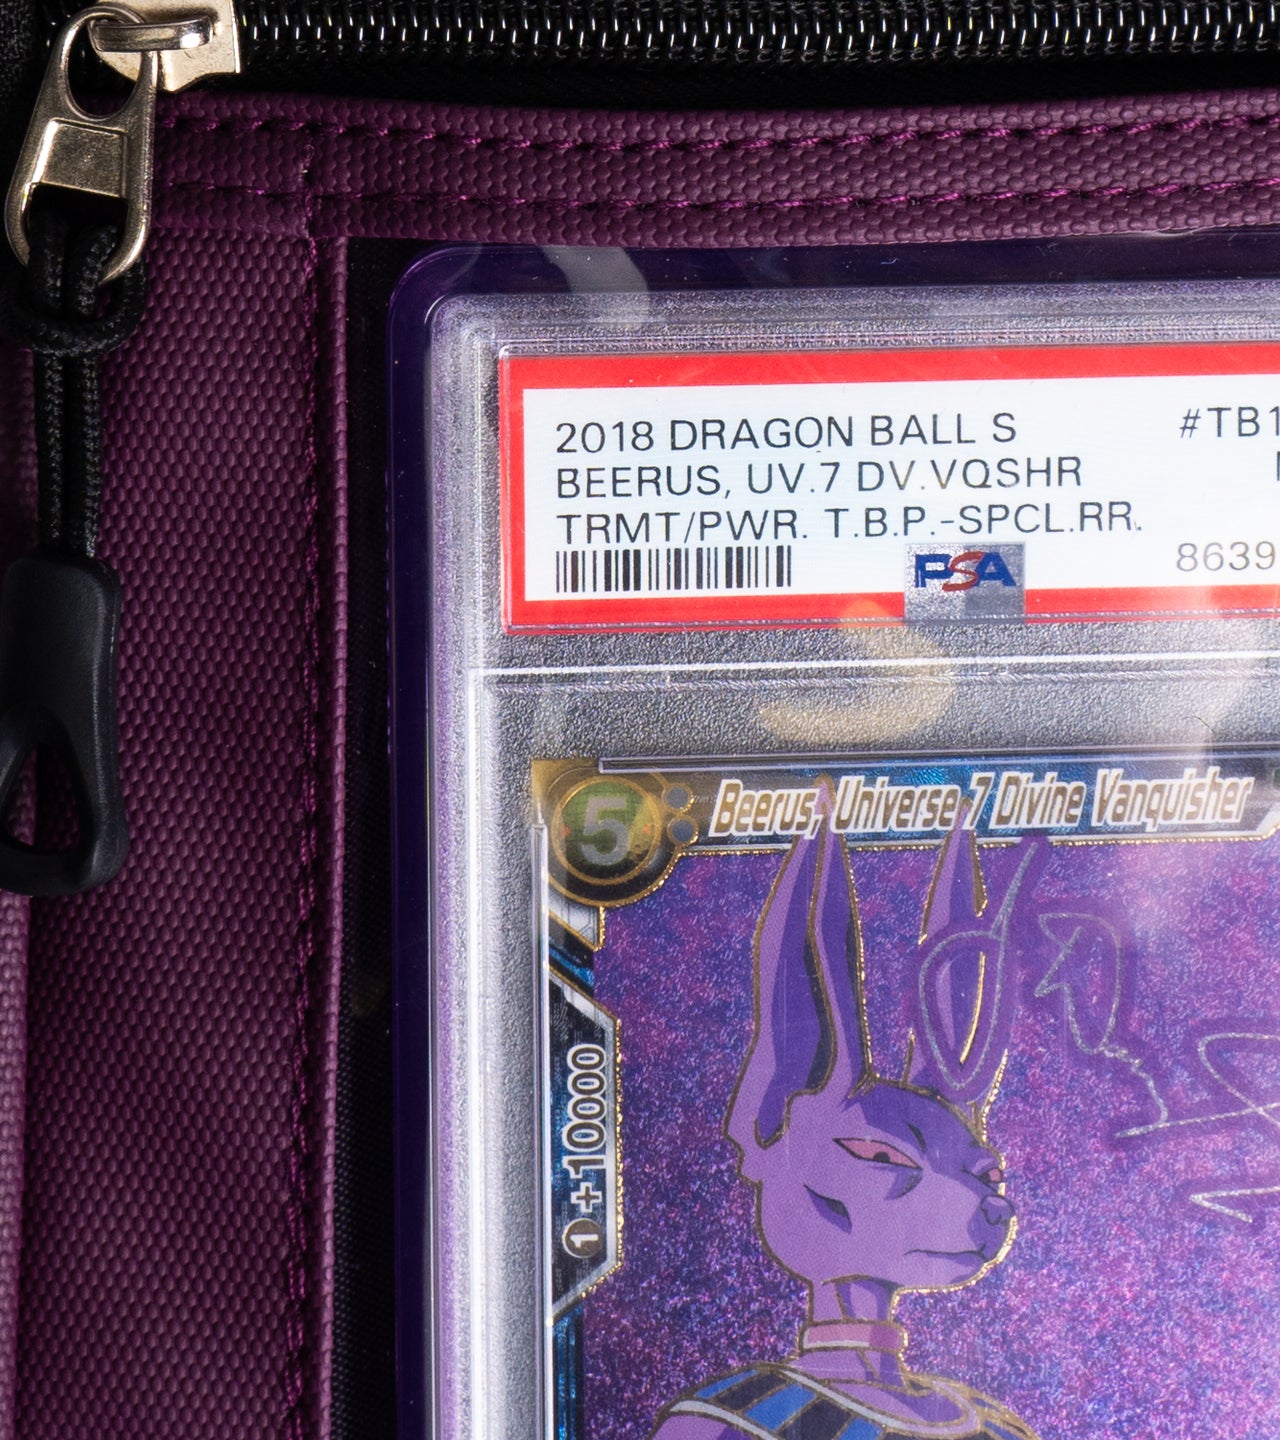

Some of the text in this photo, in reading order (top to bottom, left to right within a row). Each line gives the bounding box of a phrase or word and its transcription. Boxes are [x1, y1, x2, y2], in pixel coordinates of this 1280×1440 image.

[555, 413, 1017, 454] 2018 DRAGON BALL S
[557, 456, 1082, 500] BEERUS, UV.7 DV.VQSHR
[556, 509, 808, 545] TRMT/PWR.
[915, 551, 1016, 592] PSA
[709, 766, 1256, 840] Beerus, Universe 7 Divine Vanquisher
[581, 796, 630, 866] 5
[562, 1043, 607, 1249] 1 +10000
